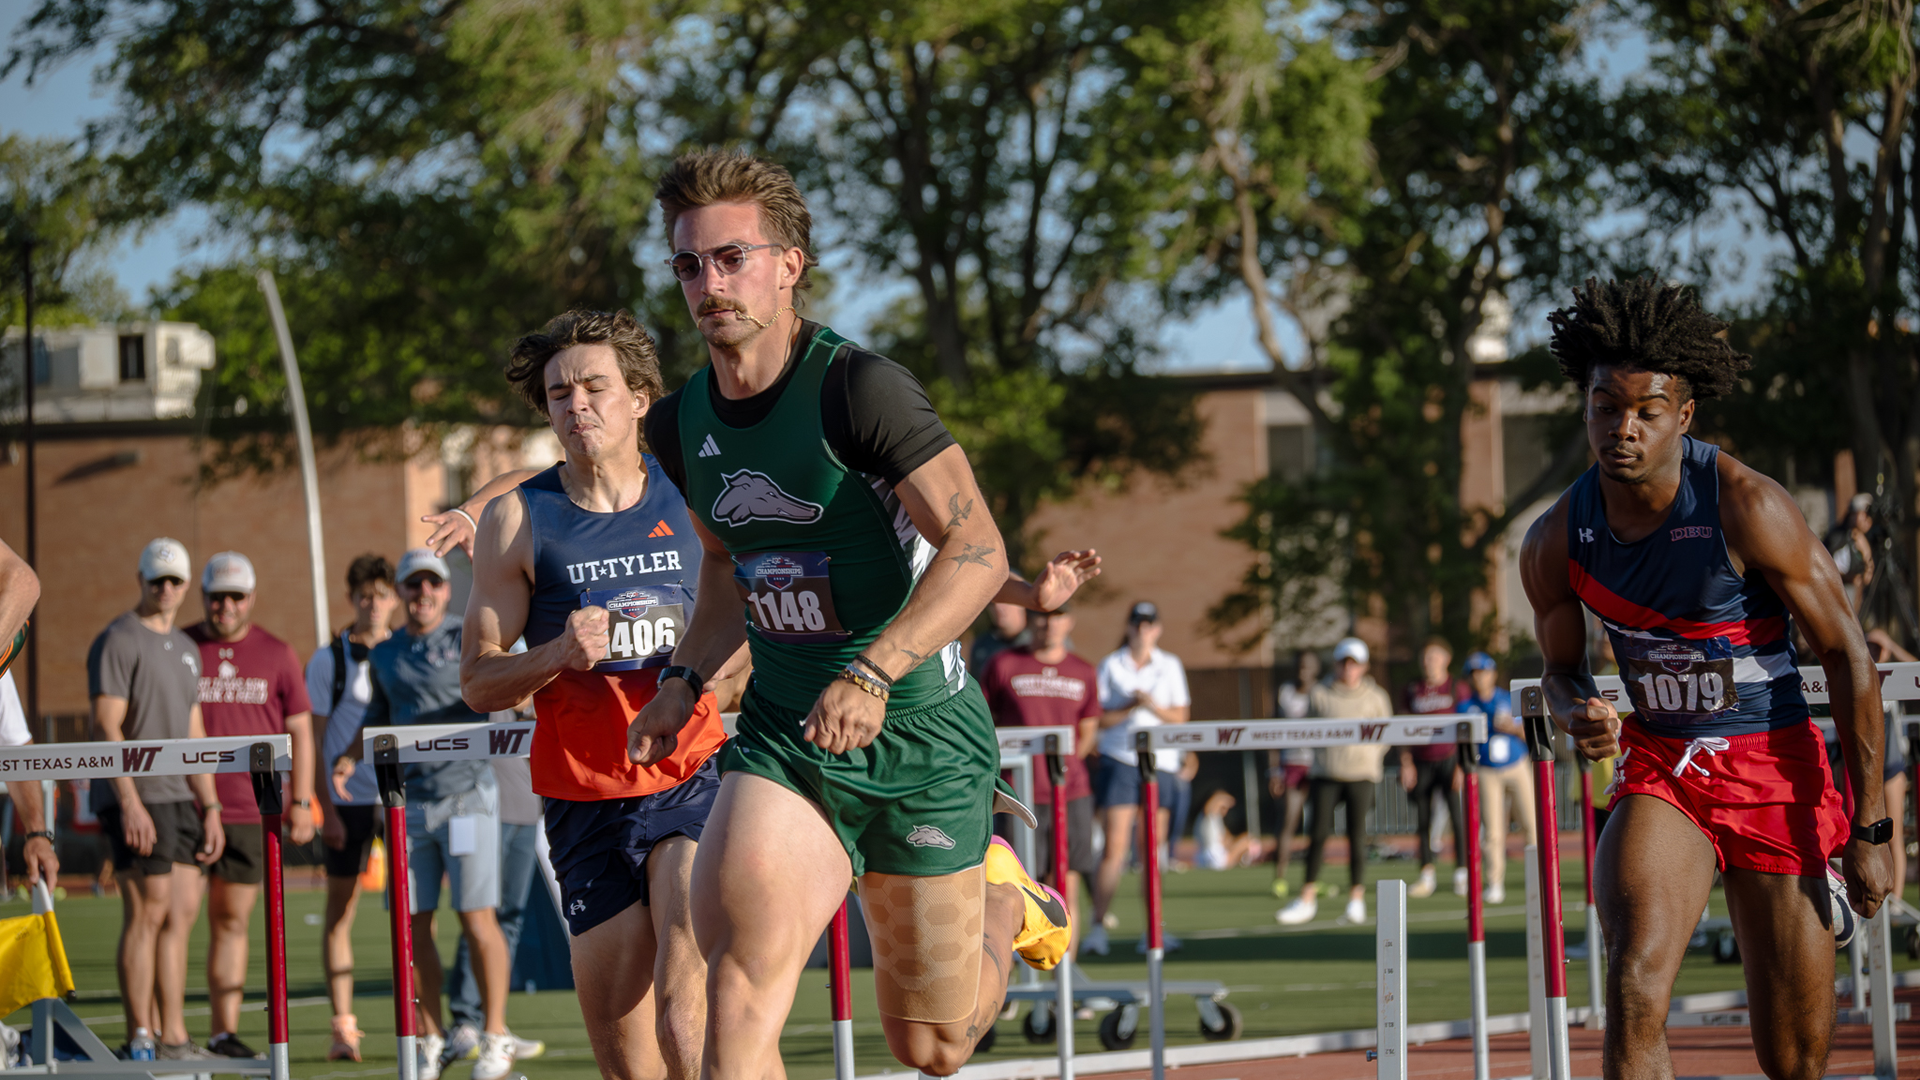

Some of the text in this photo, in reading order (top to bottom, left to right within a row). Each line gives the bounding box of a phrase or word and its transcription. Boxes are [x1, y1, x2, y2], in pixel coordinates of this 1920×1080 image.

[1670, 526, 1712, 541] DBU
[603, 550, 682, 578] TYLER
[747, 591, 826, 631] 1148
[1638, 672, 1724, 711] 1079
[1801, 681, 1828, 693] A&
[415, 728, 531, 755] UCS WT
[1163, 732, 1203, 744] UCS
[1216, 726, 1247, 745] WT
[1251, 731, 1283, 741] WEST
[1287, 729, 1322, 740] TEXAS
[1359, 723, 1390, 741] WT
[1404, 726, 1444, 737] UCS
[0, 746, 236, 772] ST TEXAS A&M WT UCS
